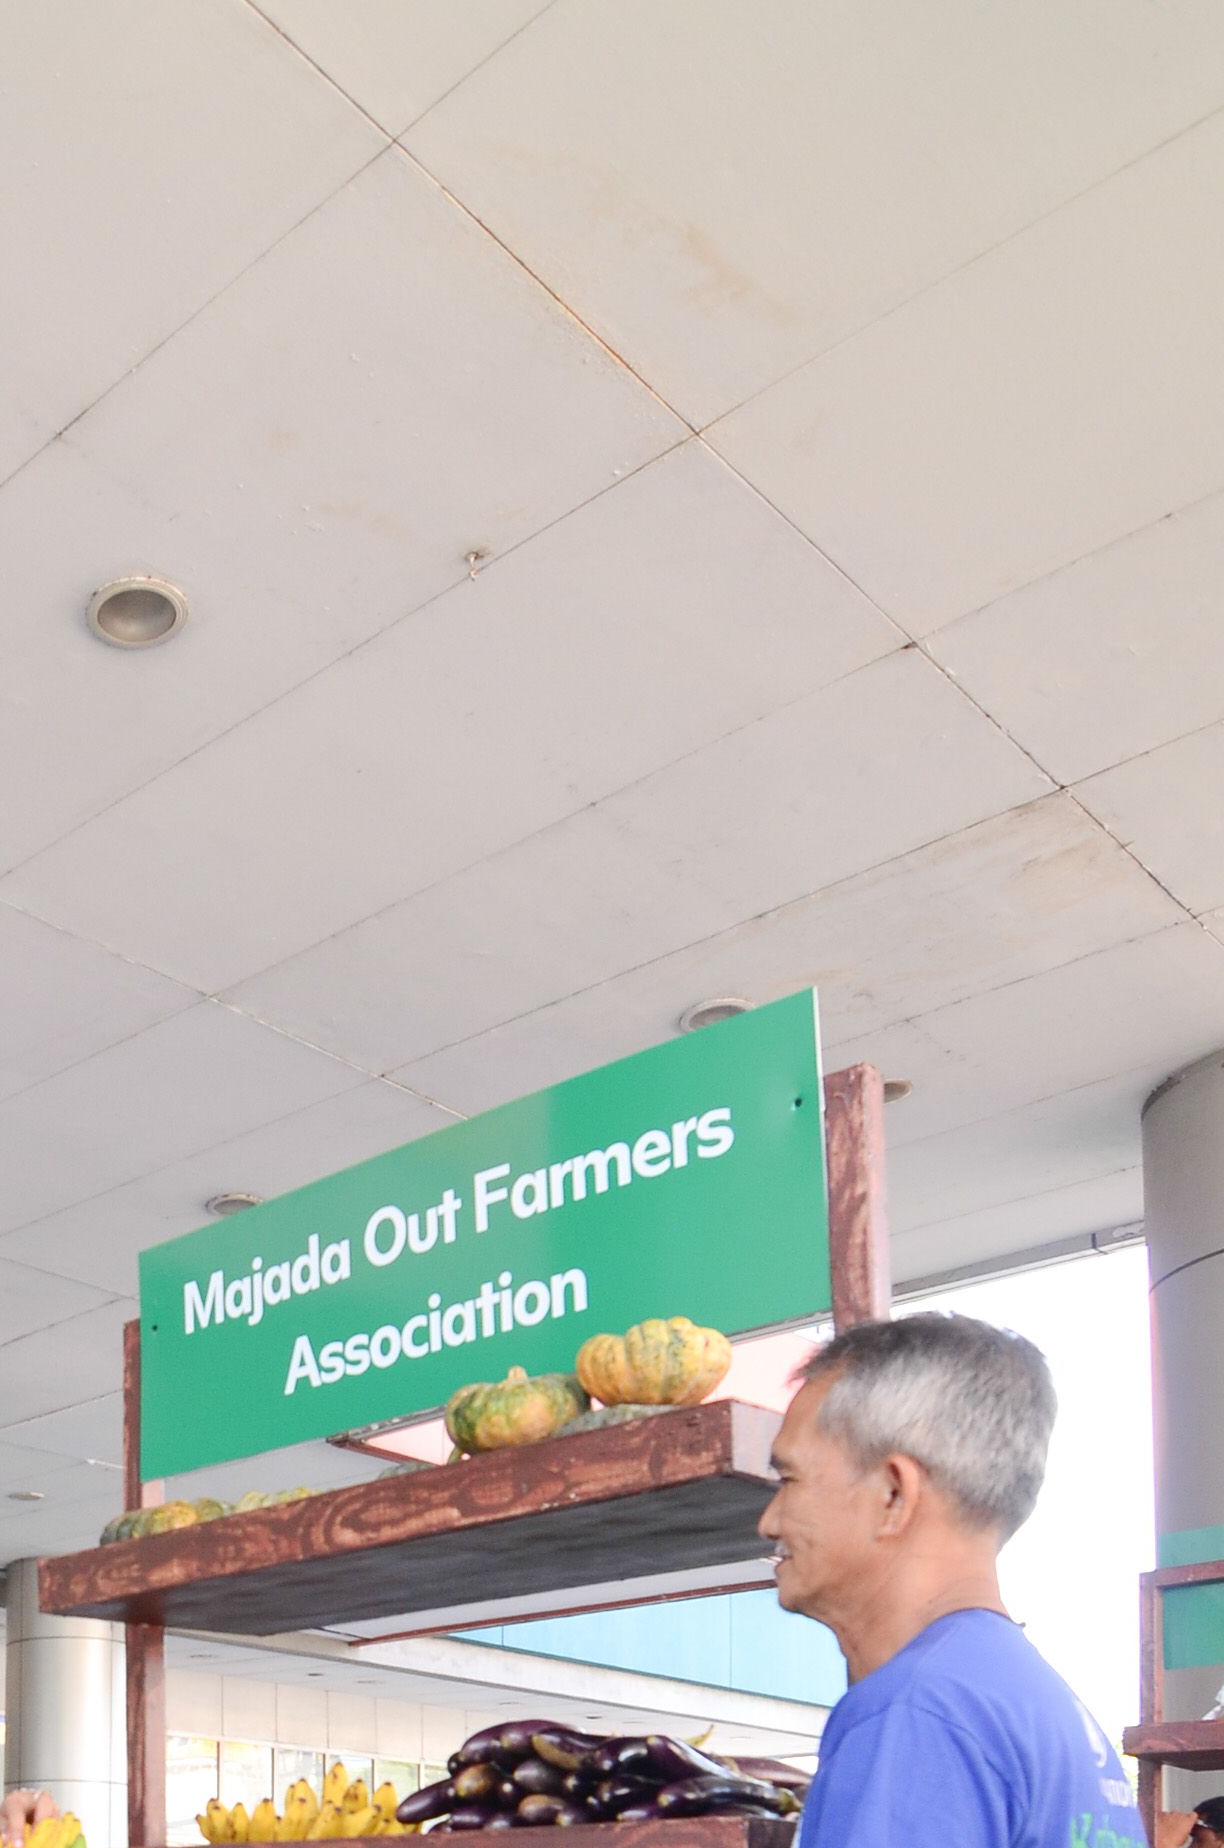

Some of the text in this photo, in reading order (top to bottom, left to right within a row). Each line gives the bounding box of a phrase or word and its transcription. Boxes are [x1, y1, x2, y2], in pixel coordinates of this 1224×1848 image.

[183, 1107, 735, 1334] Majada Out Farmers
[284, 1267, 588, 1395] Association
